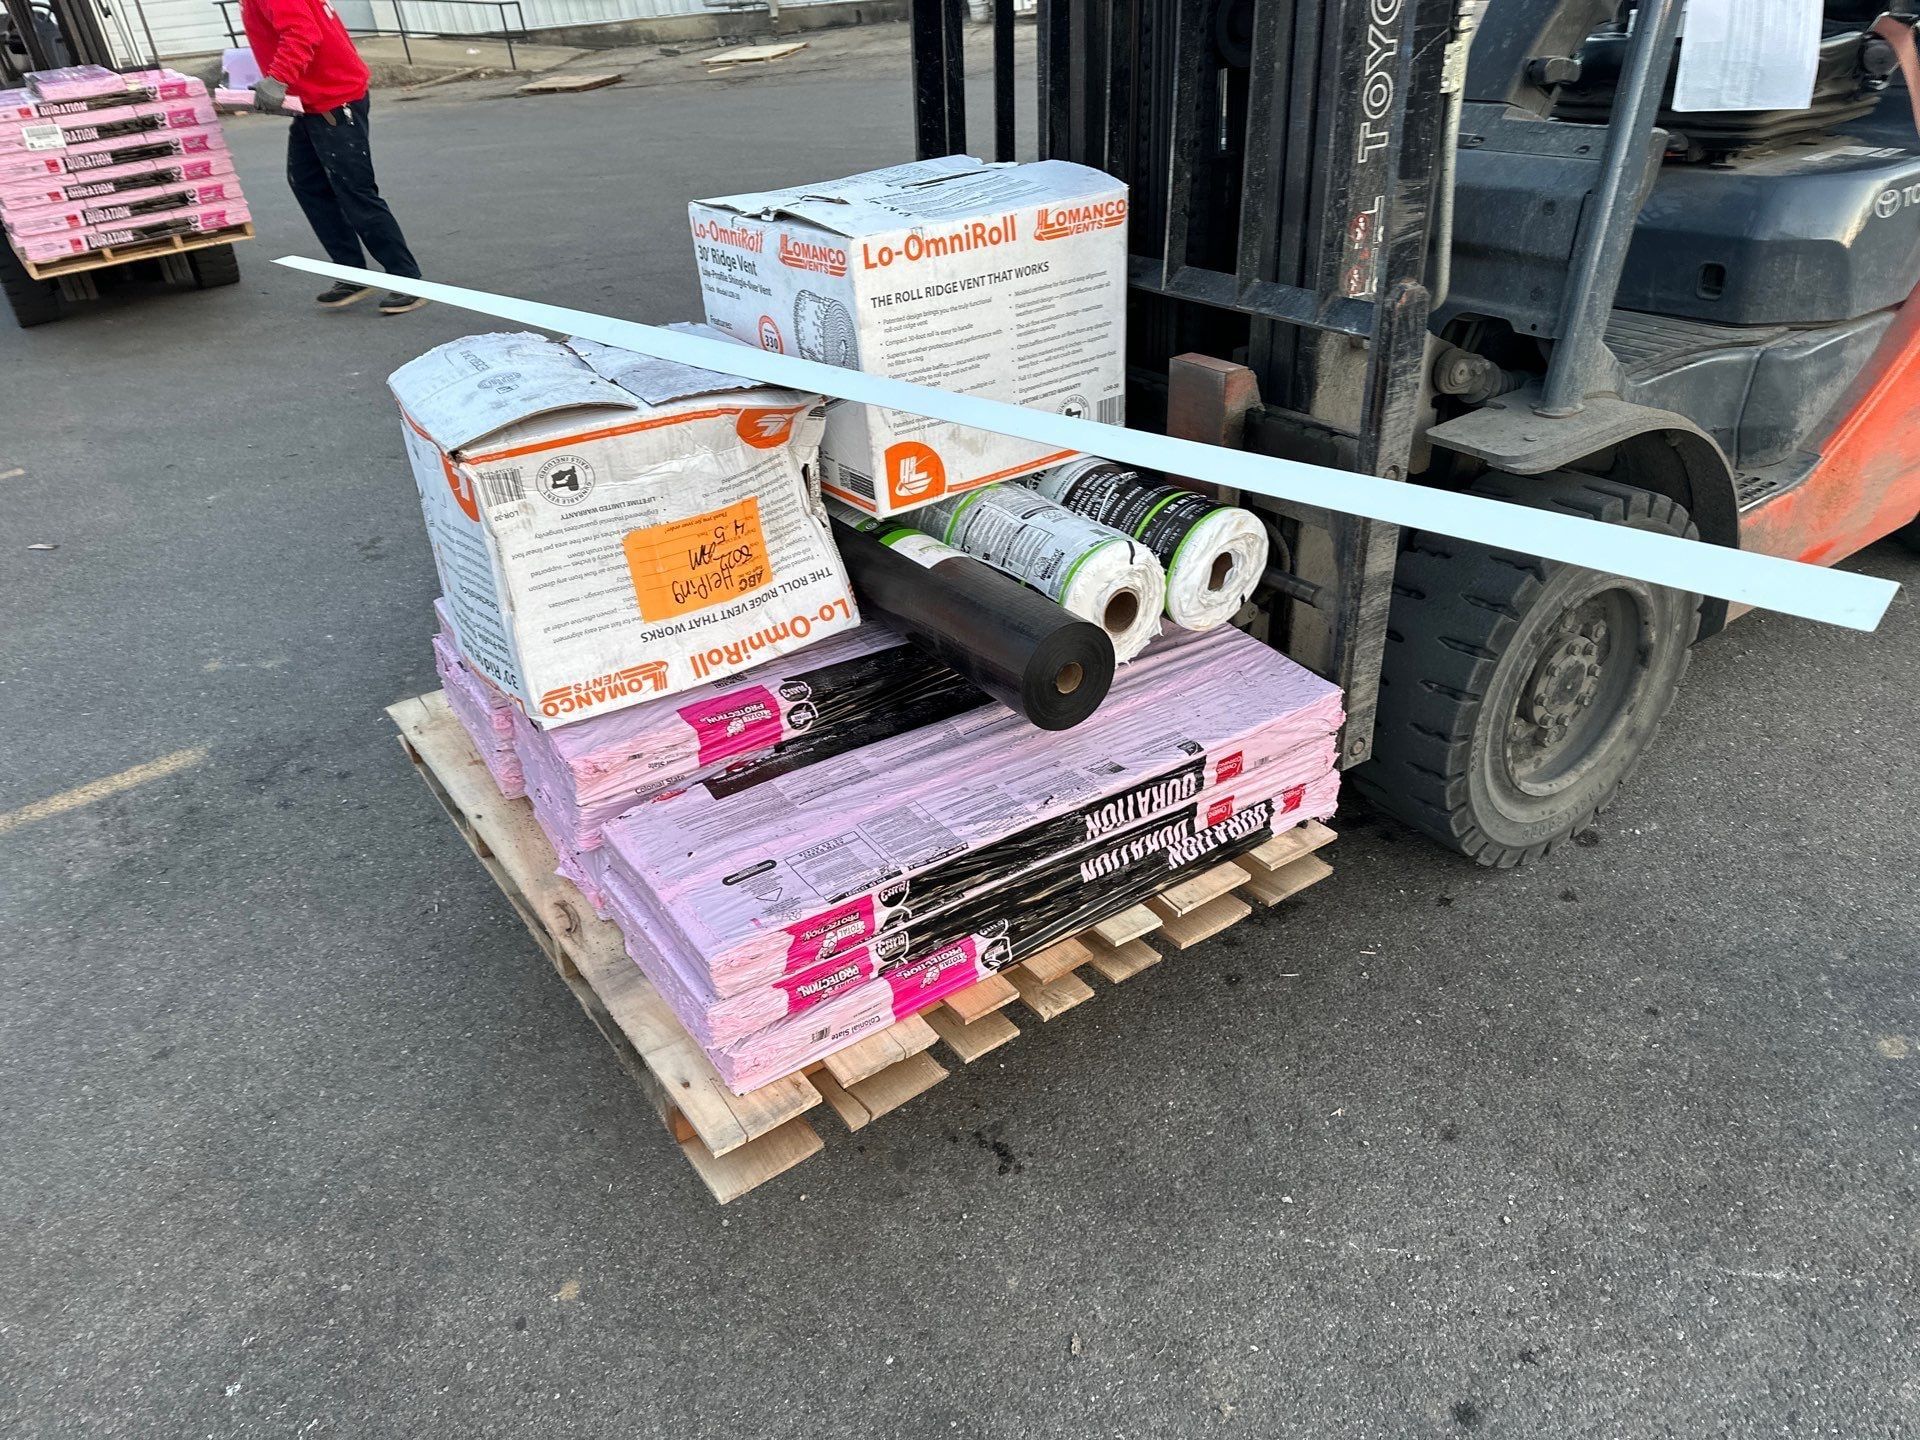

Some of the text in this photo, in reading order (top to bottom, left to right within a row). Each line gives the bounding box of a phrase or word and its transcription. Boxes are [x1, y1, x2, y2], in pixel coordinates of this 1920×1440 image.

[63, 127, 99, 142] RATION
[66, 153, 113, 170] DURATION
[86, 206, 131, 224] DURATION
[1037, 198, 1127, 228] LOMANCO
[692, 216, 763, 253] Lo-OmniRoll
[1068, 219, 1104, 235] VENTS
[88, 230, 134, 248] DURATION
[862, 214, 1017, 269] Lo-OmniRoll
[780, 234, 847, 266] LOMANCO
[711, 248, 736, 271] Ridge
[738, 255, 758, 276] Vent
[803, 261, 829, 274] VENTS
[870, 260, 1049, 309] THE ROLL RIDGE VENT THAT WORKS
[765, 335, 778, 349] 330
[539, 457, 569, 479] INCLUDED
[543, 490, 560, 503] VENT
[562, 481, 592, 504] GUNNABLE
[560, 494, 655, 521] LIFETIME LIMITED WARRANTY
[712, 511, 727, 520] Thank
[1090, 505, 1101, 519] LATE
[534, 506, 658, 541] Engineered material guarantees longevity
[663, 524, 680, 534] order!
[680, 520, 693, 528] your
[693, 517, 702, 525] for
[732, 517, 746, 535] 4
[569, 538, 581, 546] free
[600, 529, 620, 539] inches
[713, 525, 726, 545] 5
[525, 547, 542, 556] linear
[542, 542, 554, 551] per
[566, 543, 614, 559] not crush down
[511, 551, 525, 561] foot
[570, 557, 591, 567] inches
[596, 551, 613, 562] every
[687, 540, 718, 571] AM
[530, 564, 561, 578] supported
[568, 572, 583, 582] from
[583, 570, 597, 578] flow
[527, 580, 555, 592] direction
[556, 576, 567, 584] any
[737, 569, 766, 591] ABC
[547, 589, 604, 609] design maximizes
[640, 567, 833, 643] THE ROLL RIDGE VENT THAT WORKS
[570, 614, 595, 625] effective
[595, 607, 616, 618] proven
[551, 621, 569, 630] under
[584, 626, 597, 635] easy
[598, 623, 609, 631] and
[610, 620, 621, 628] fast
[552, 630, 583, 644] alignment
[690, 598, 850, 680] Lo-OmniRoll
[572, 672, 621, 692] VENTS
[542, 667, 669, 717] LOMANCO
[707, 703, 764, 724] PROTECTION
[743, 711, 766, 723] TOTAL
[635, 773, 686, 794] Colonial Slate
[1085, 772, 1197, 840] DURATION
[1167, 802, 1268, 870] DURATION
[880, 892, 888, 902] 3
[803, 912, 860, 941] PROTECTION
[838, 924, 860, 939] TOTAL
[877, 934, 905, 955] CLASS 3
[901, 947, 961, 978] PROTECTION
[801, 965, 860, 997] PROTECTION
[832, 1015, 881, 1040] Colonial Slate
